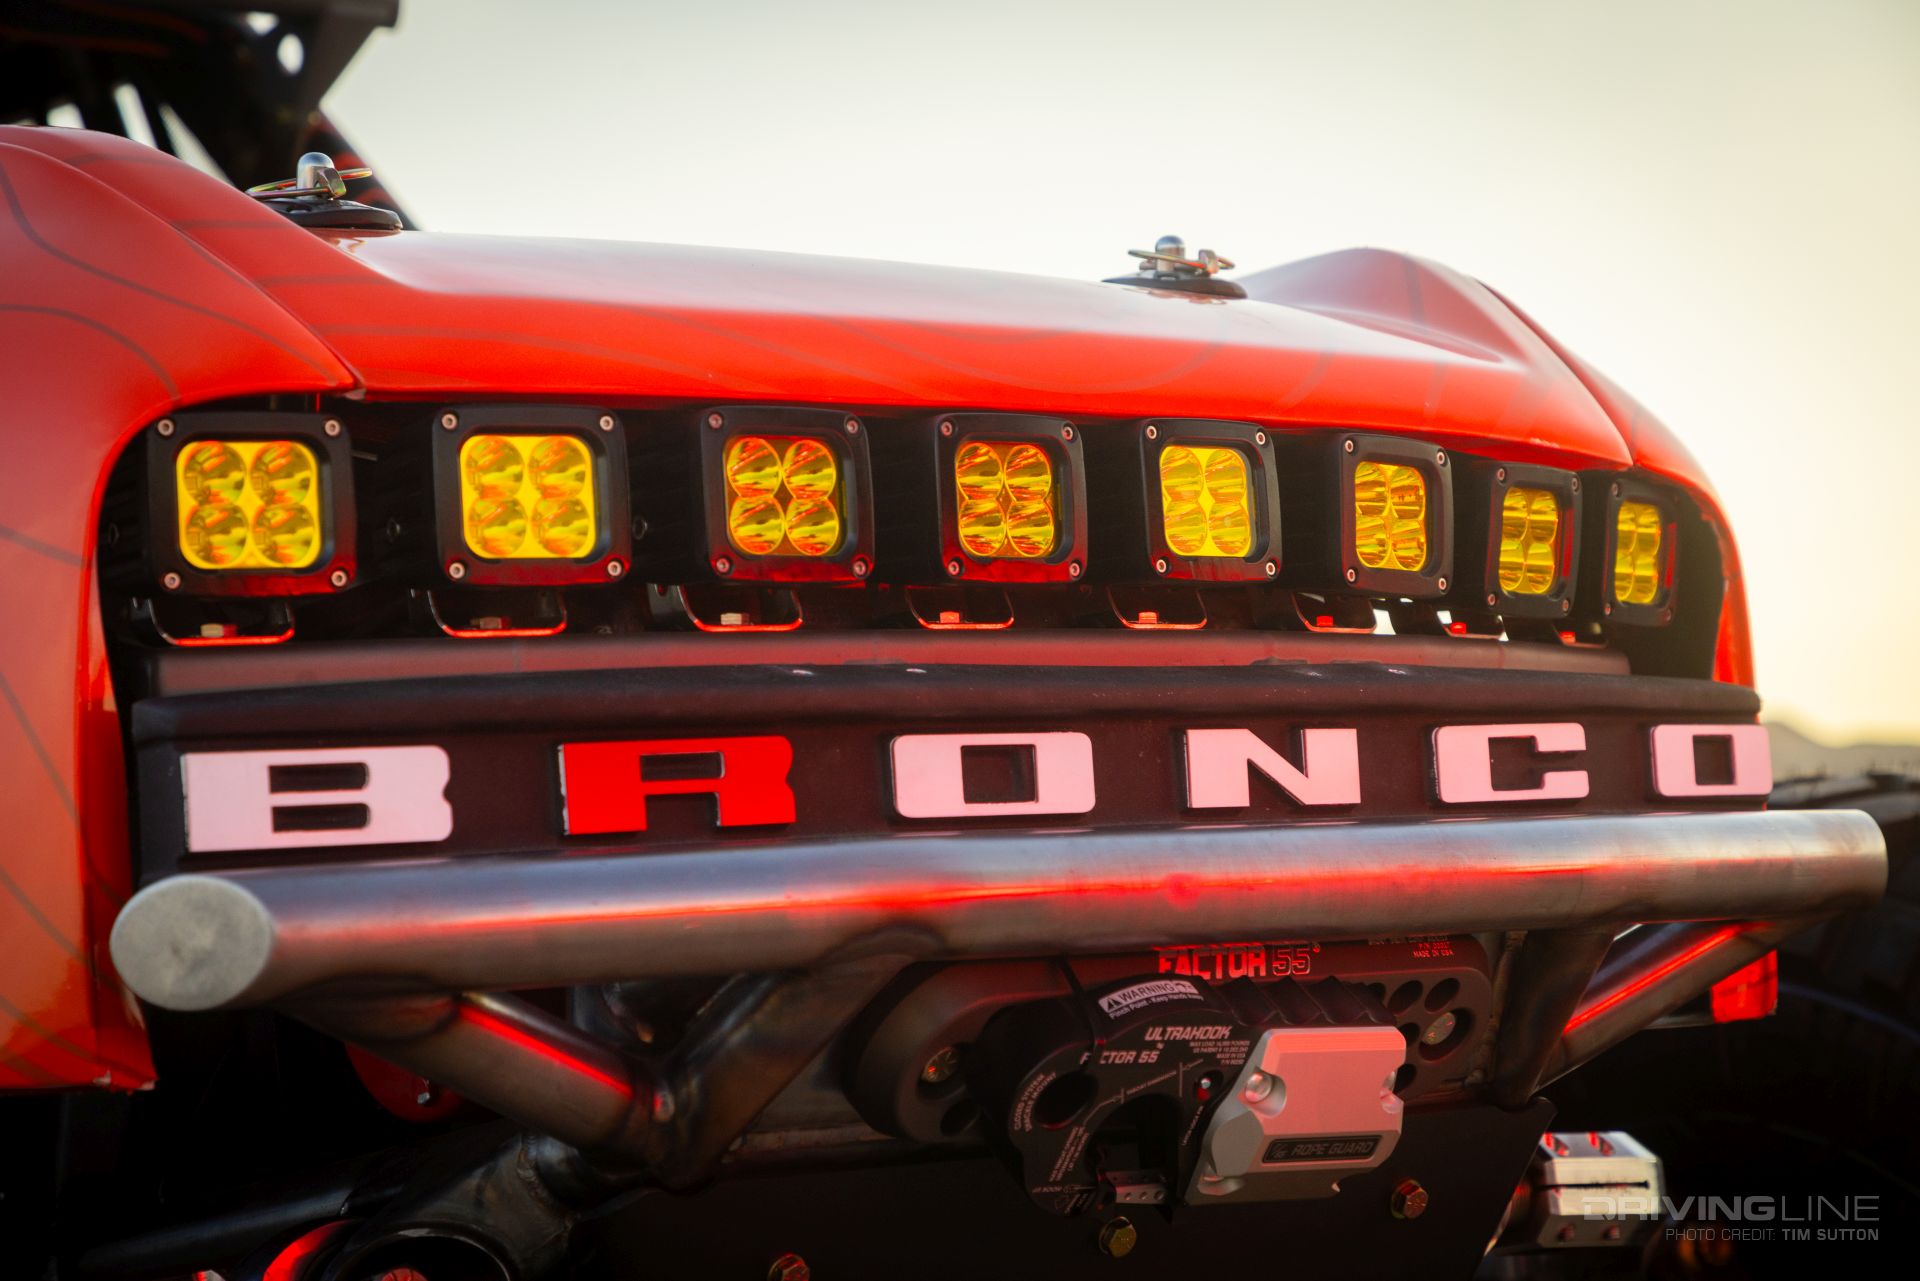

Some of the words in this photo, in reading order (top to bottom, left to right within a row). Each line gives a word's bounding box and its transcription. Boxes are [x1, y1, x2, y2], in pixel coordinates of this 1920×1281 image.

[182, 721, 1773, 853] BRONCO
[1157, 943, 1267, 980] FACTOR
[1119, 983, 1175, 1002] WARNING
[1108, 1006, 1130, 1020] Pinch
[1129, 998, 1149, 1011] Point
[1144, 1026, 1232, 1041] ULTRAHOOK
[1080, 1050, 1136, 1065] FCTOR
[1138, 1050, 1160, 1064] 55
[1031, 1071, 1057, 1099] MOUNT
[1292, 1143, 1328, 1155] ROPE
[1328, 1141, 1374, 1154] GUARD
